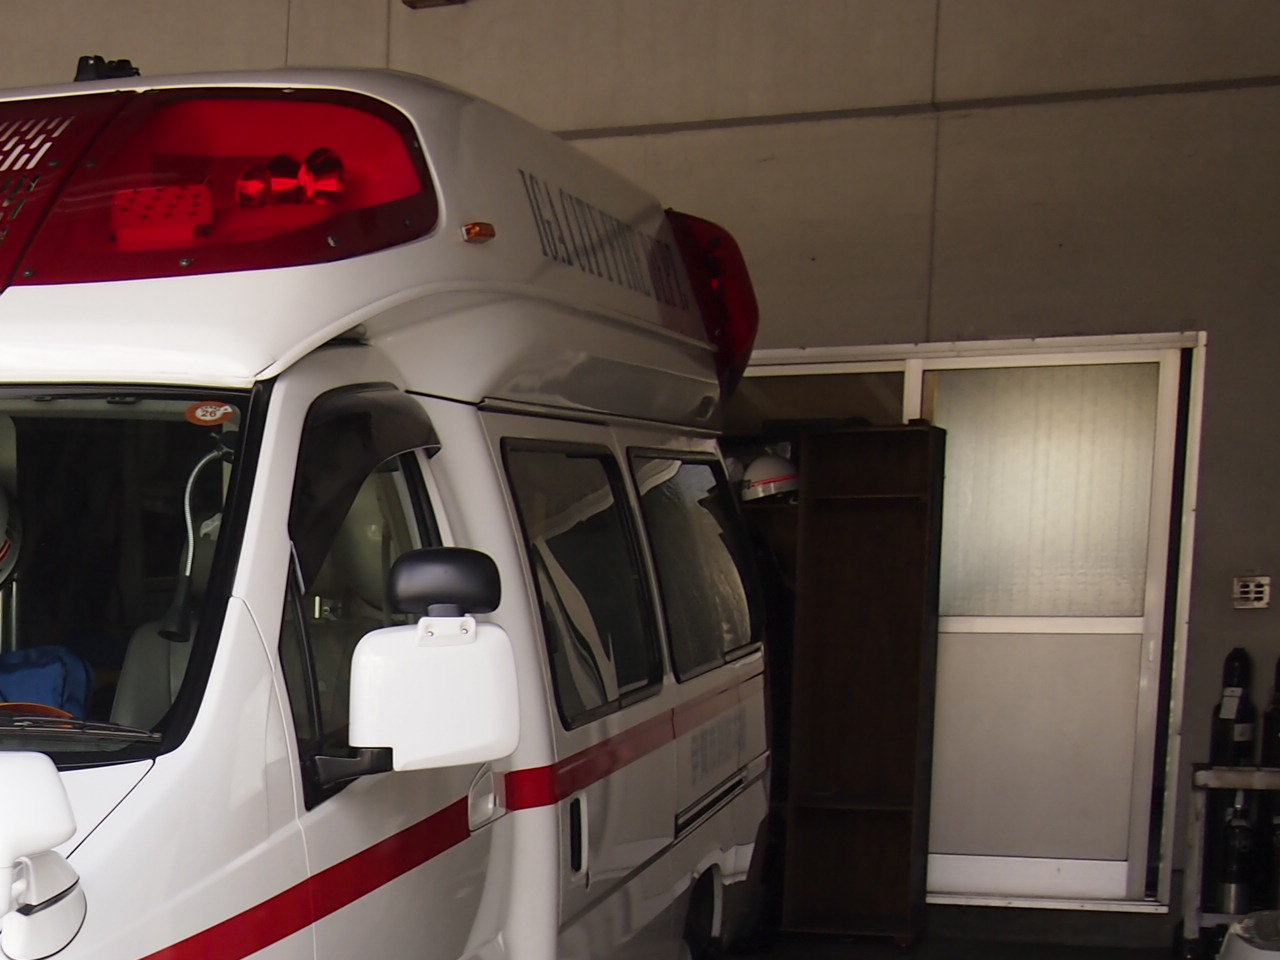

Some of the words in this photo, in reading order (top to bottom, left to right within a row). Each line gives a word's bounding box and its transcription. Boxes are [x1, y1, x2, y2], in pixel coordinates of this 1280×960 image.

[518, 168, 574, 266] IGA
[559, 188, 614, 283] CITY
[200, 409, 217, 418] 26
